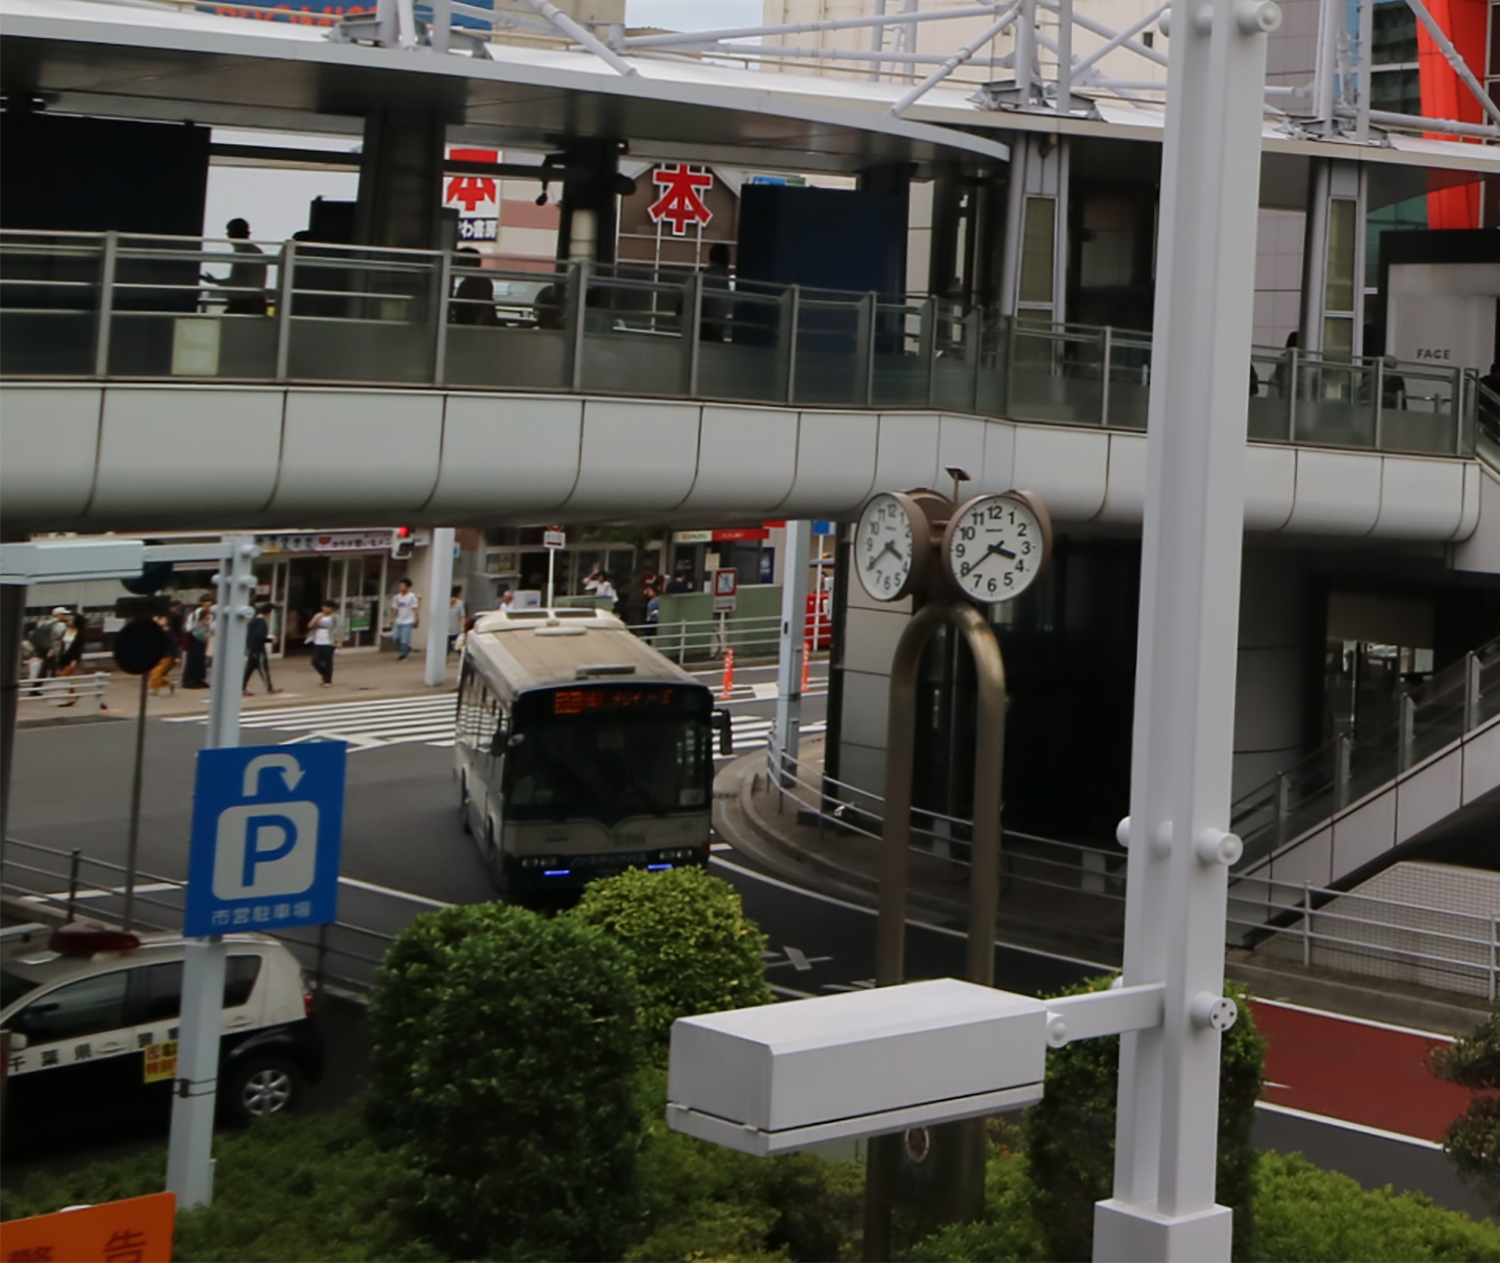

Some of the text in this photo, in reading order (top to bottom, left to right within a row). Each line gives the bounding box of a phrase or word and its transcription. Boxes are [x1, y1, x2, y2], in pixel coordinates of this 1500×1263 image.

[648, 155, 713, 233] 本
[1416, 348, 1451, 360] FACE
[988, 506, 1003, 519] 12
[1017, 523, 1027, 536] 2
[955, 544, 965, 558] 9
[1022, 541, 1031, 554] 3
[1015, 560, 1024, 572] 4
[973, 574, 983, 588] 7
[988, 579, 997, 592] 6
[1004, 572, 1013, 586] 5
[242, 814, 298, 888] P
[211, 901, 312, 926] 市営駐車場
